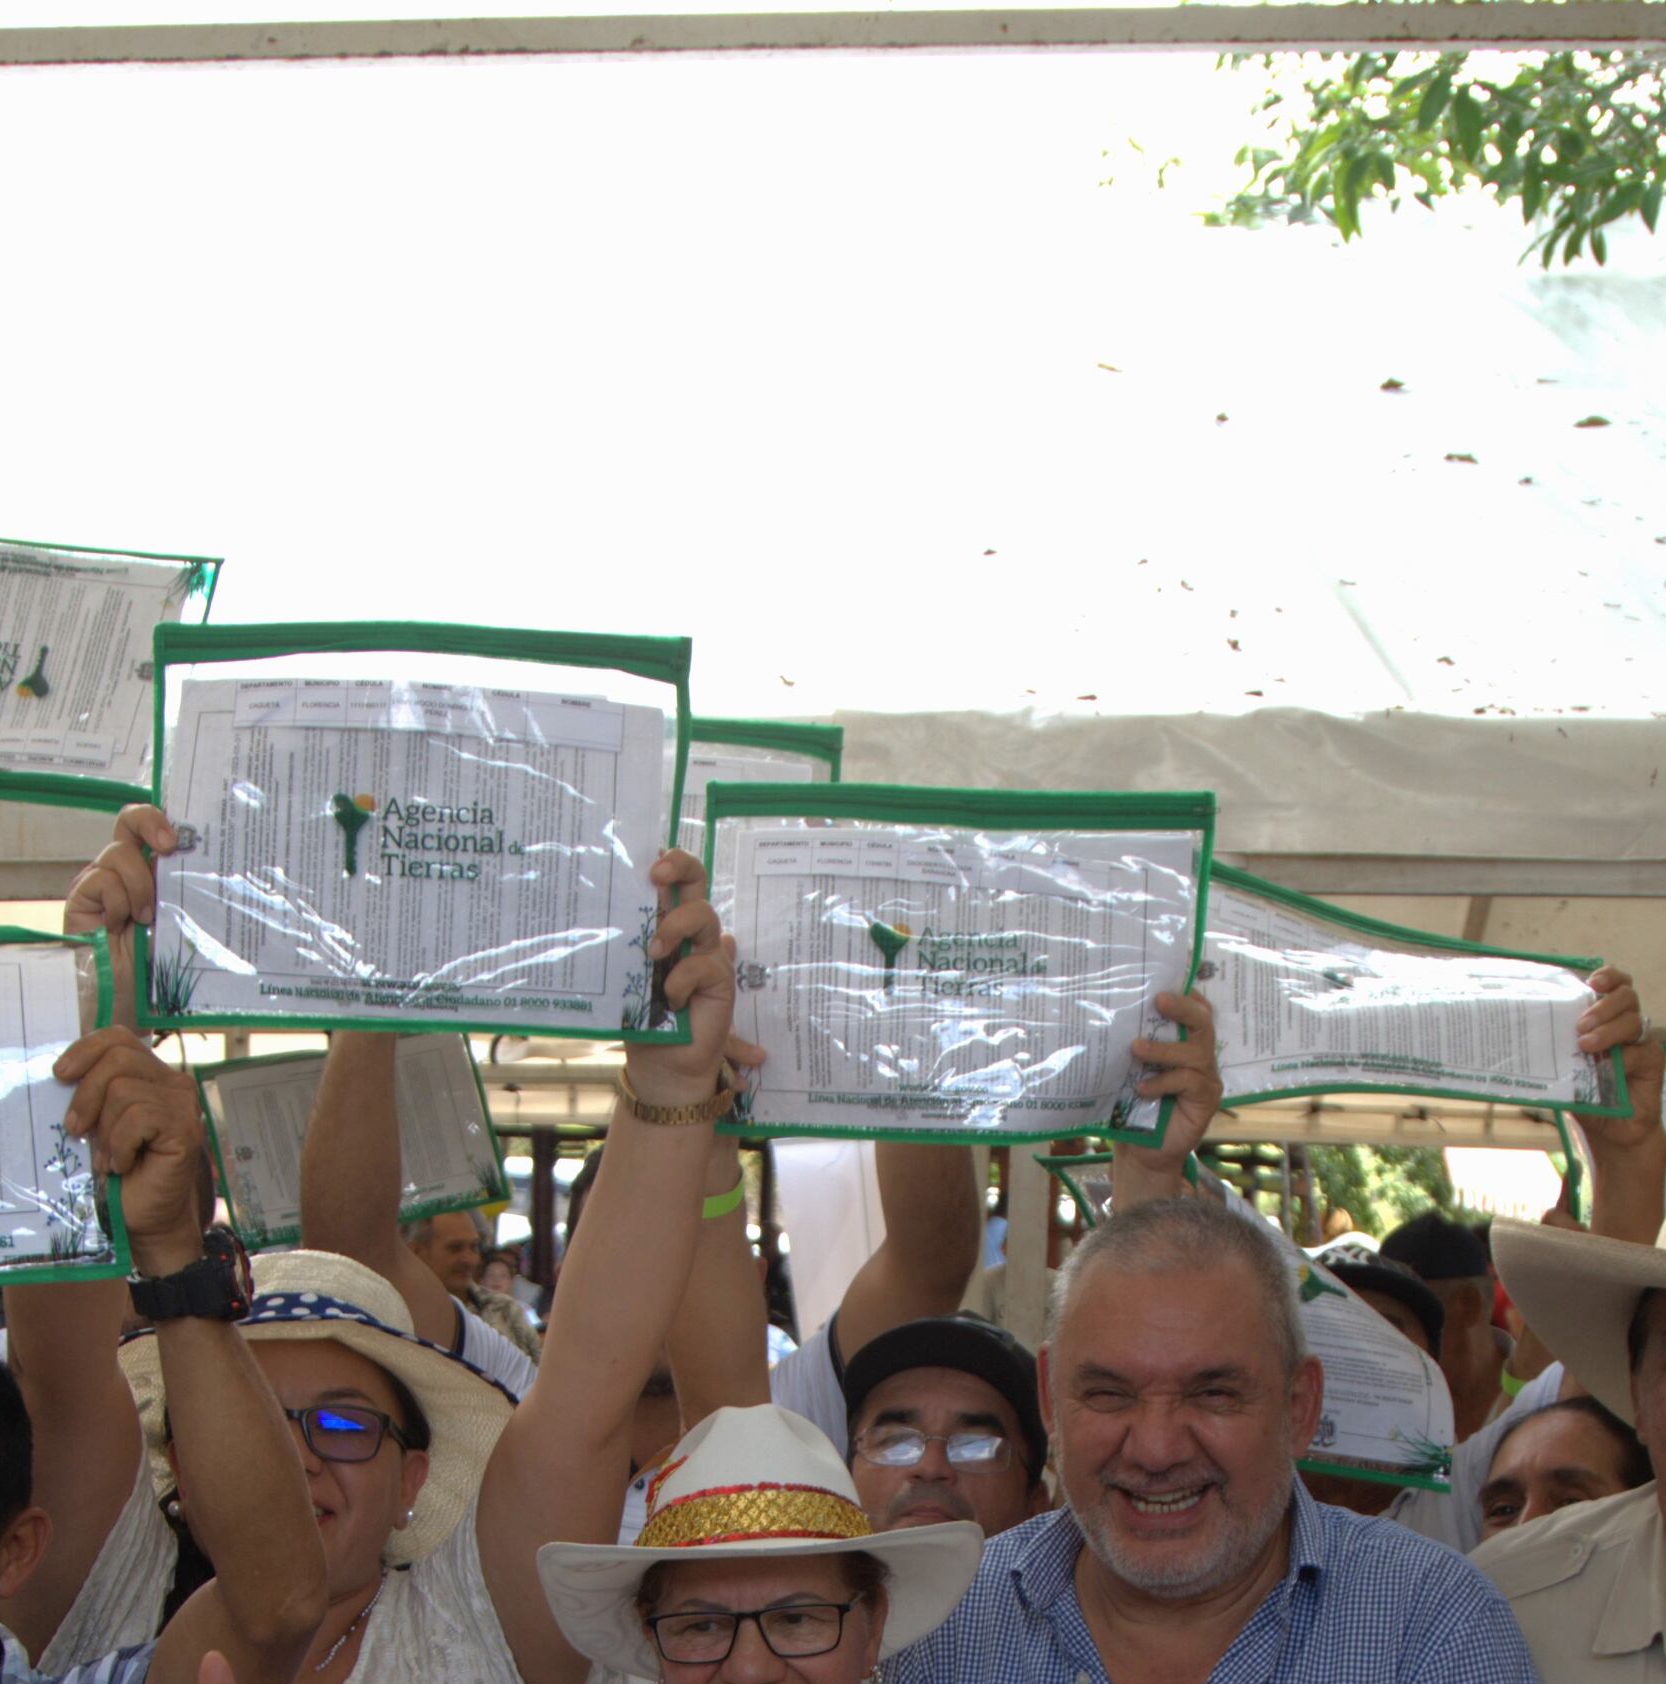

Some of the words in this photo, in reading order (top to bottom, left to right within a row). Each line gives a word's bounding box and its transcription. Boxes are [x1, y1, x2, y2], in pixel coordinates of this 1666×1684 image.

[240, 680, 293, 690] DEPARTAMENTO
[304, 680, 340, 688] MUNICIPIO
[382, 797, 494, 826] Agencia
[381, 825, 505, 855] Nacional
[509, 839, 524, 855] de
[381, 853, 479, 881] Tierras
[917, 926, 1020, 953] Agencia
[917, 952, 1027, 974] Nacional
[259, 983, 293, 997] Línea
[504, 995, 518, 1007] 01
[915, 975, 1003, 998] Tierras
